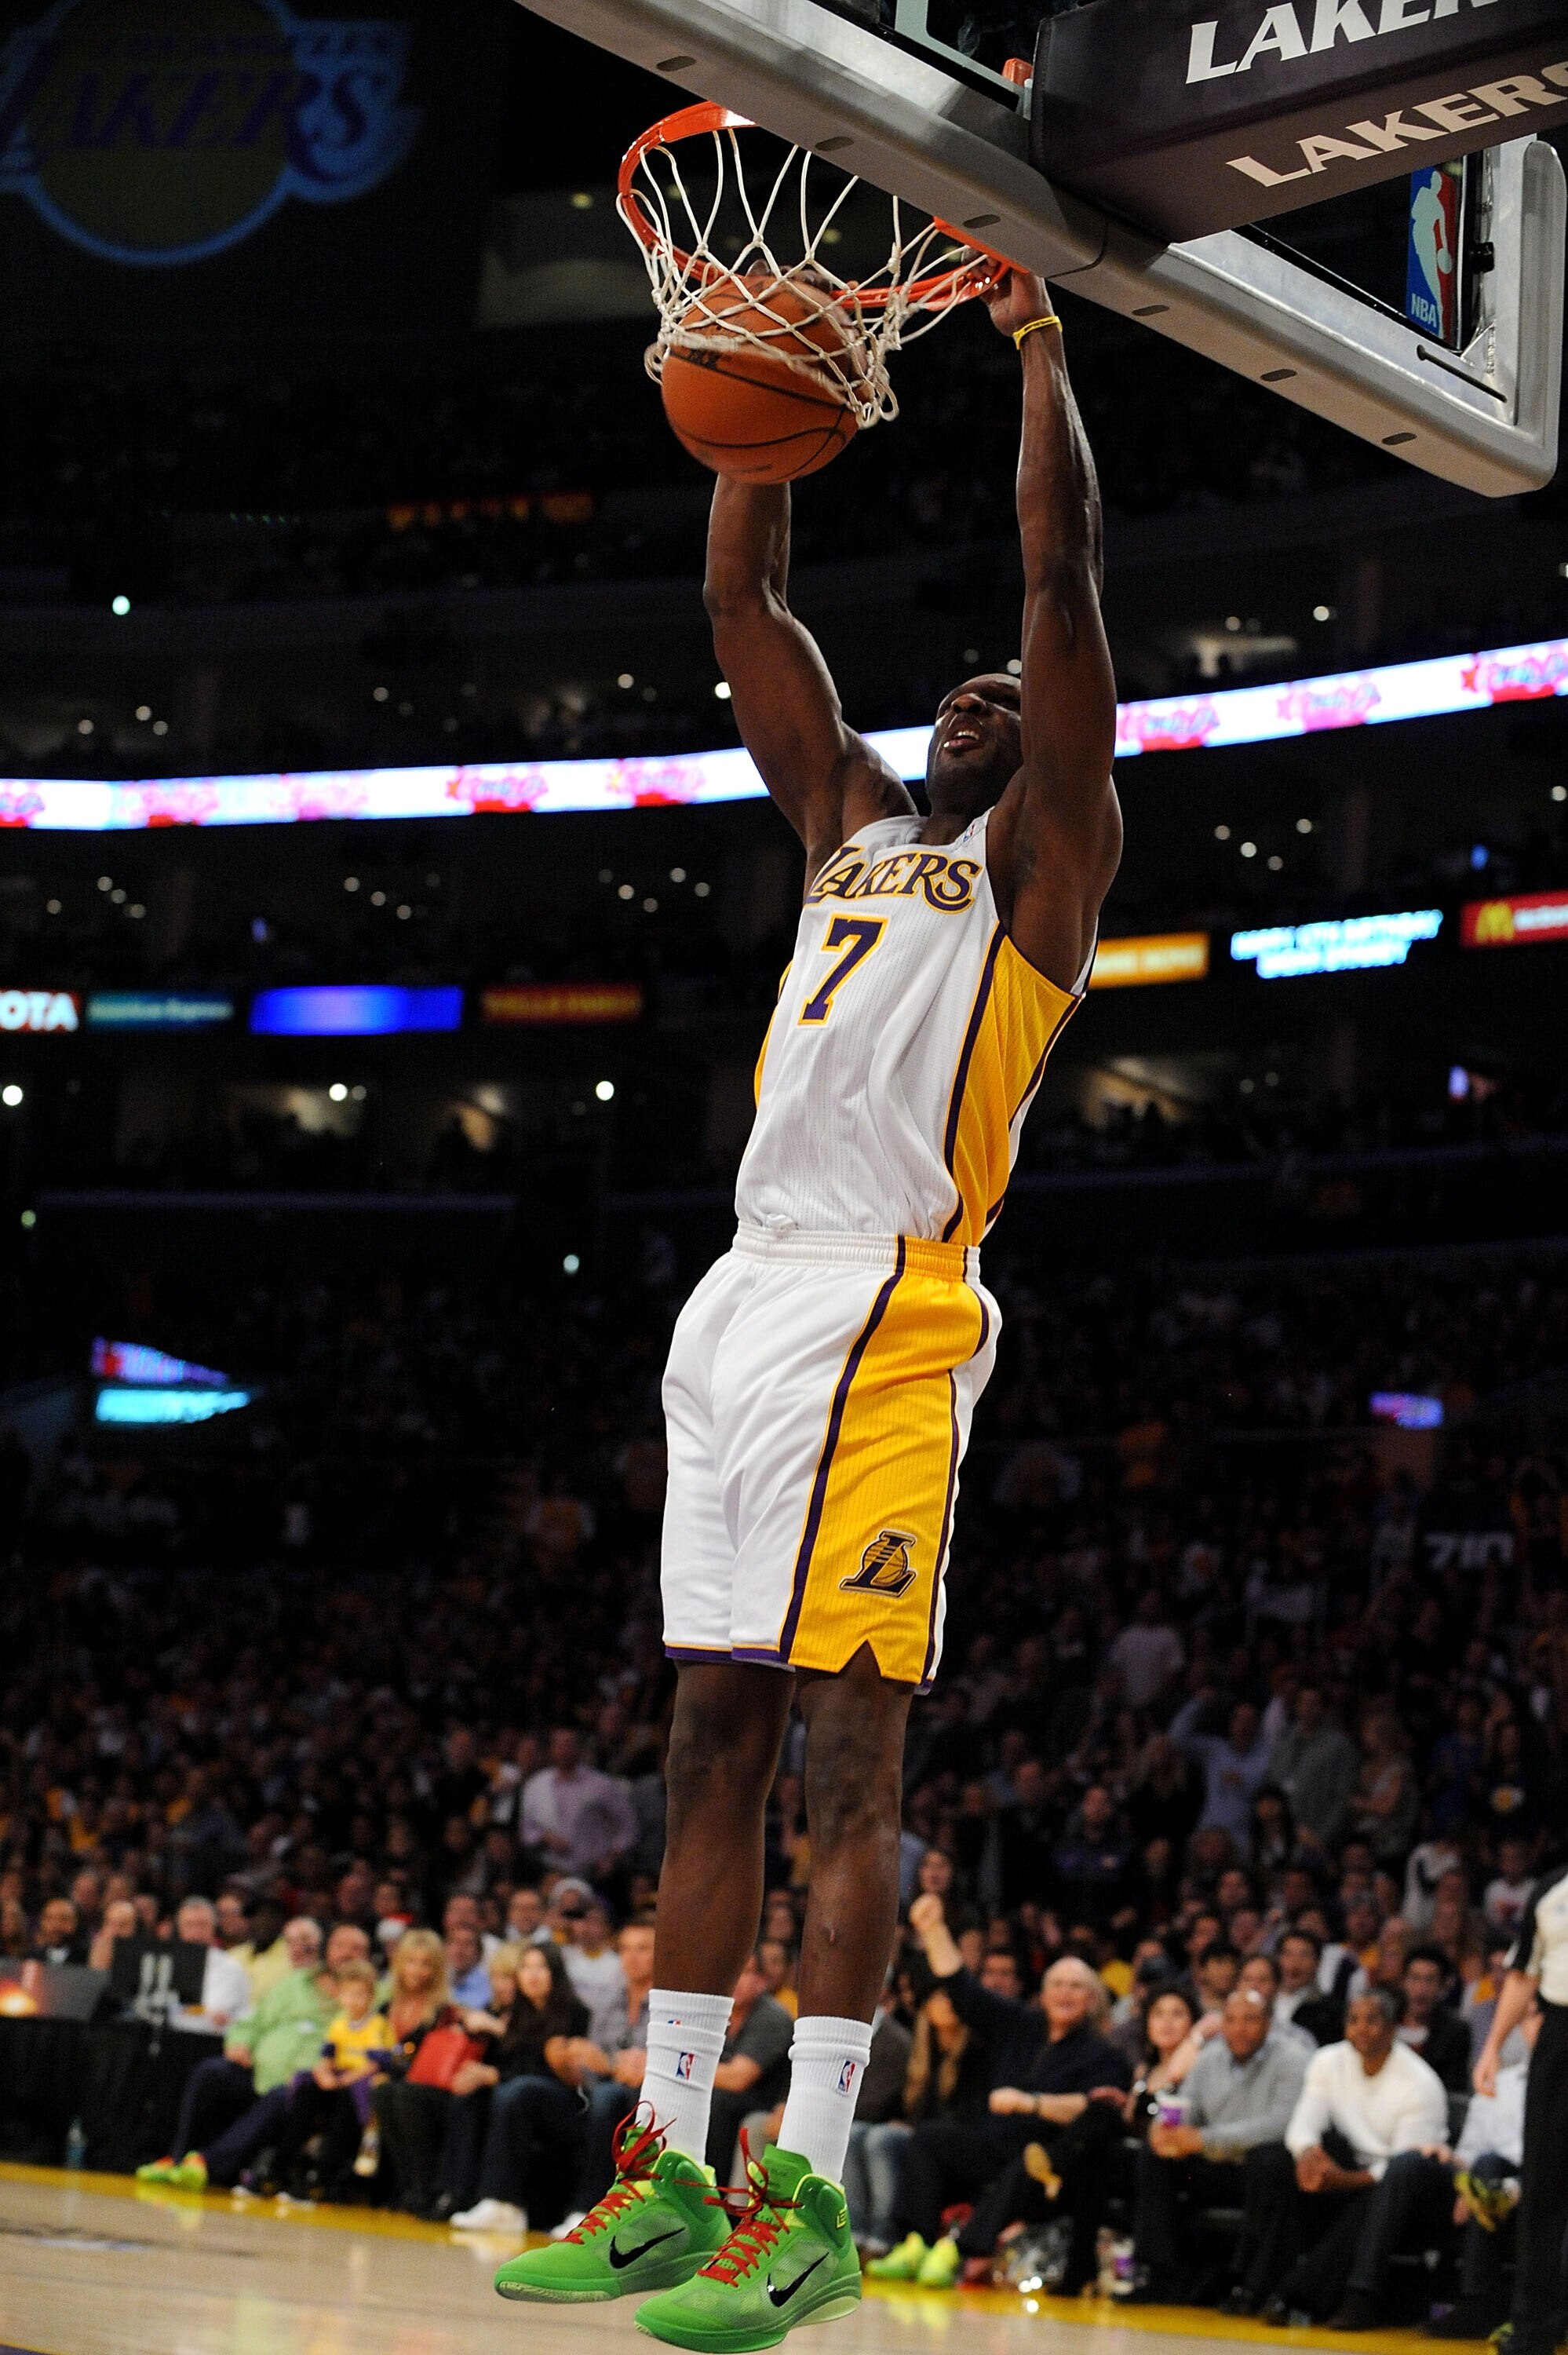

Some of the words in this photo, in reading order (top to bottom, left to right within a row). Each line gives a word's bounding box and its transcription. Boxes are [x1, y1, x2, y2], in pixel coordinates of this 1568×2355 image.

[1411, 292, 1437, 328] NBA
[804, 845, 983, 914] LAKERS
[797, 913, 888, 1025] 7
